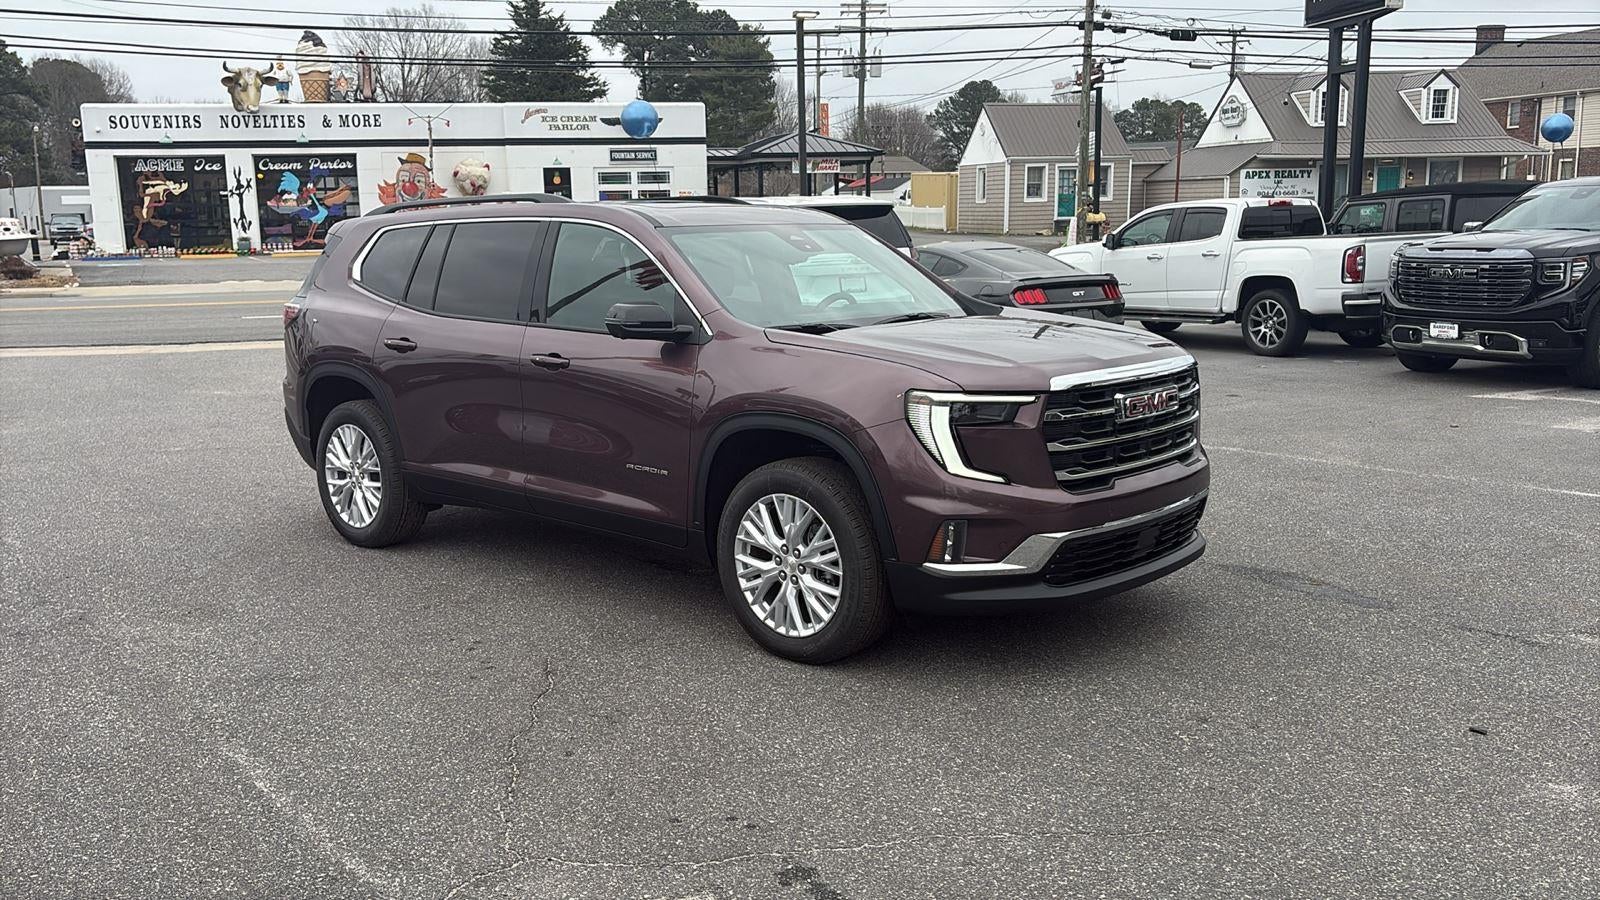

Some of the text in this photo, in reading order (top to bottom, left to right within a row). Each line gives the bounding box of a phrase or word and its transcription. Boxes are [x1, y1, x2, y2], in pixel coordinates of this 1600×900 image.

[108, 114, 382, 129] SOUVENIRS NOVELTIES & MORE
[541, 115, 558, 123] ICE
[560, 115, 598, 123] CREAM
[636, 151, 655, 159] SERVICE
[135, 158, 222, 172] ACME Ice
[259, 158, 354, 171] Cream Parlor
[1245, 169, 1312, 179] APEX REALTY
[1428, 268, 1478, 279] GMC
[1125, 388, 1179, 417] GMC
[626, 463, 668, 476] ACADIA
